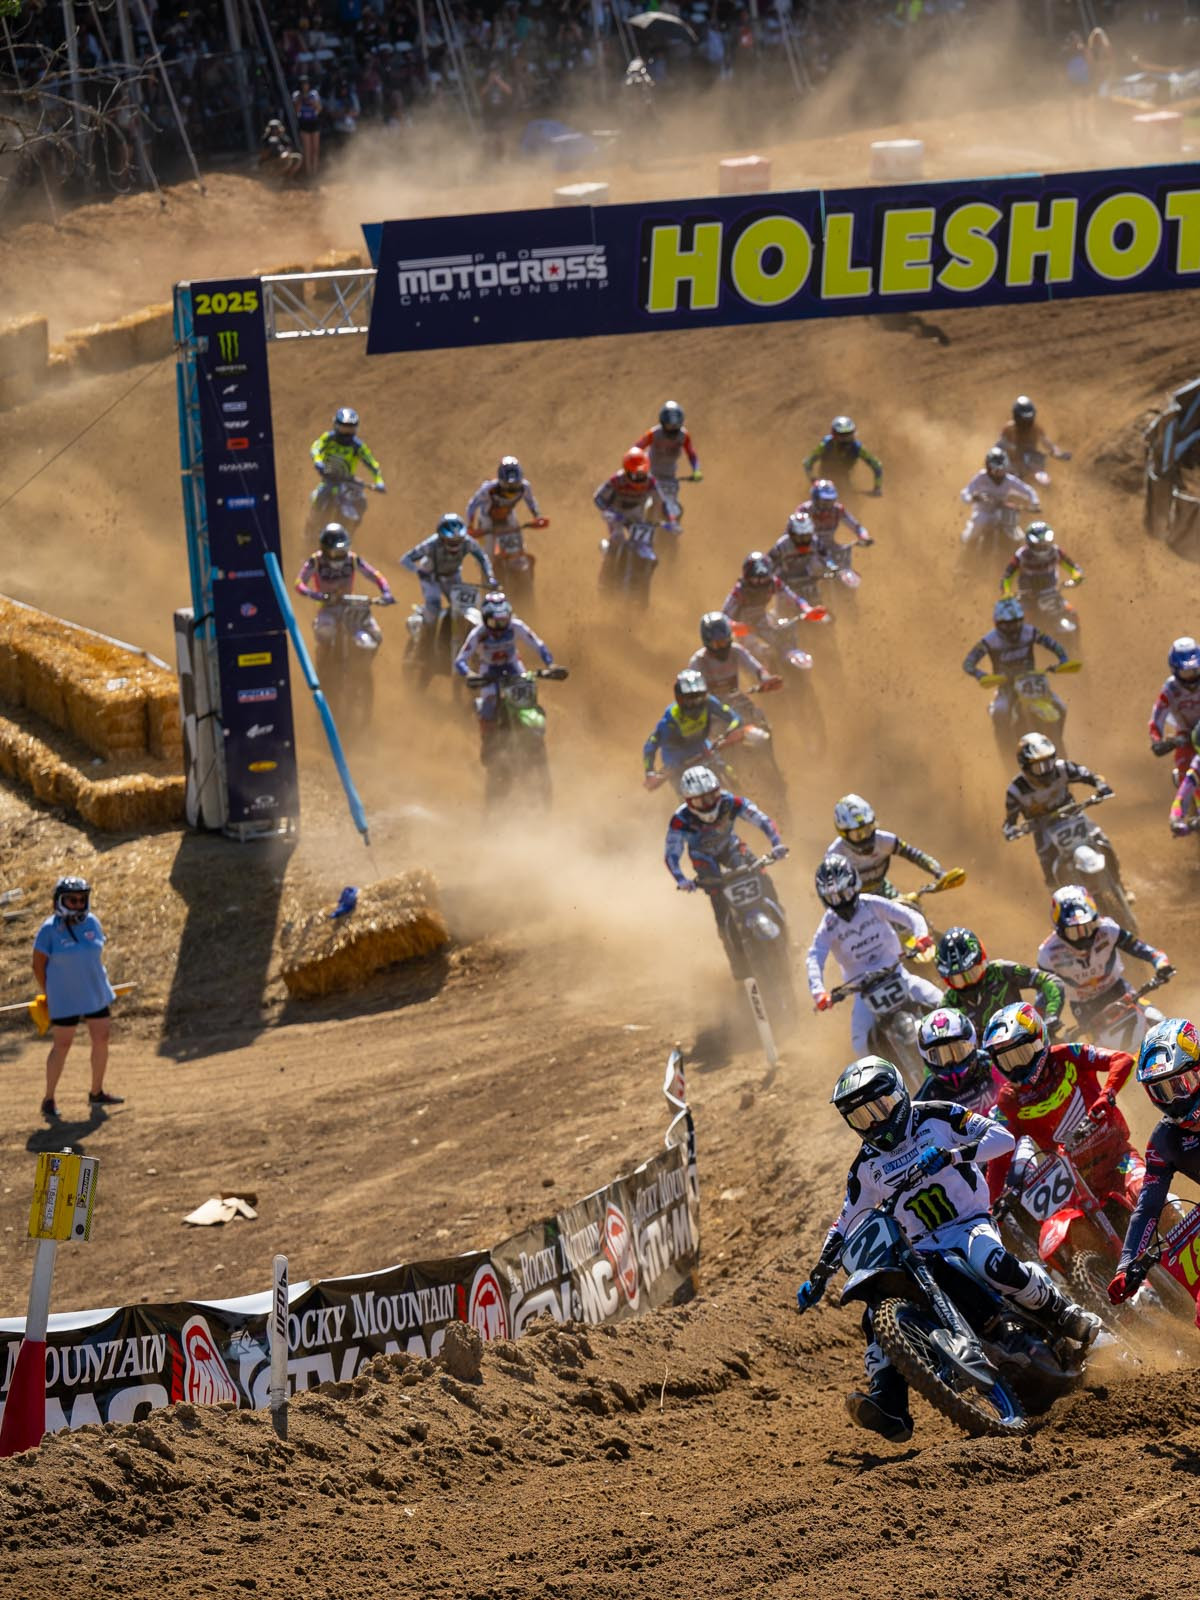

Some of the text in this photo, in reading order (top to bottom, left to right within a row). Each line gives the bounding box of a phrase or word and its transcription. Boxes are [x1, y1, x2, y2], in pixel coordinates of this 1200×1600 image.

[474, 249, 530, 263] PRO
[398, 255, 608, 296] MOTOCROSS
[400, 280, 609, 306] CHAMPIONSHIP
[195, 290, 259, 316] 2025
[1057, 822, 1088, 847] 24
[731, 881, 760, 903] 53
[872, 980, 907, 1013] 42
[1033, 1170, 1075, 1219] 96
[1169, 1211, 1200, 1243] RENTHAL
[850, 1220, 892, 1272] 2
[519, 1245, 559, 1294] ROCKY
[267, 1284, 456, 1353] OCKY MOUNTAIN
[275, 1287, 287, 1337] UFO
[933, 1294, 962, 1331] DUNLOP
